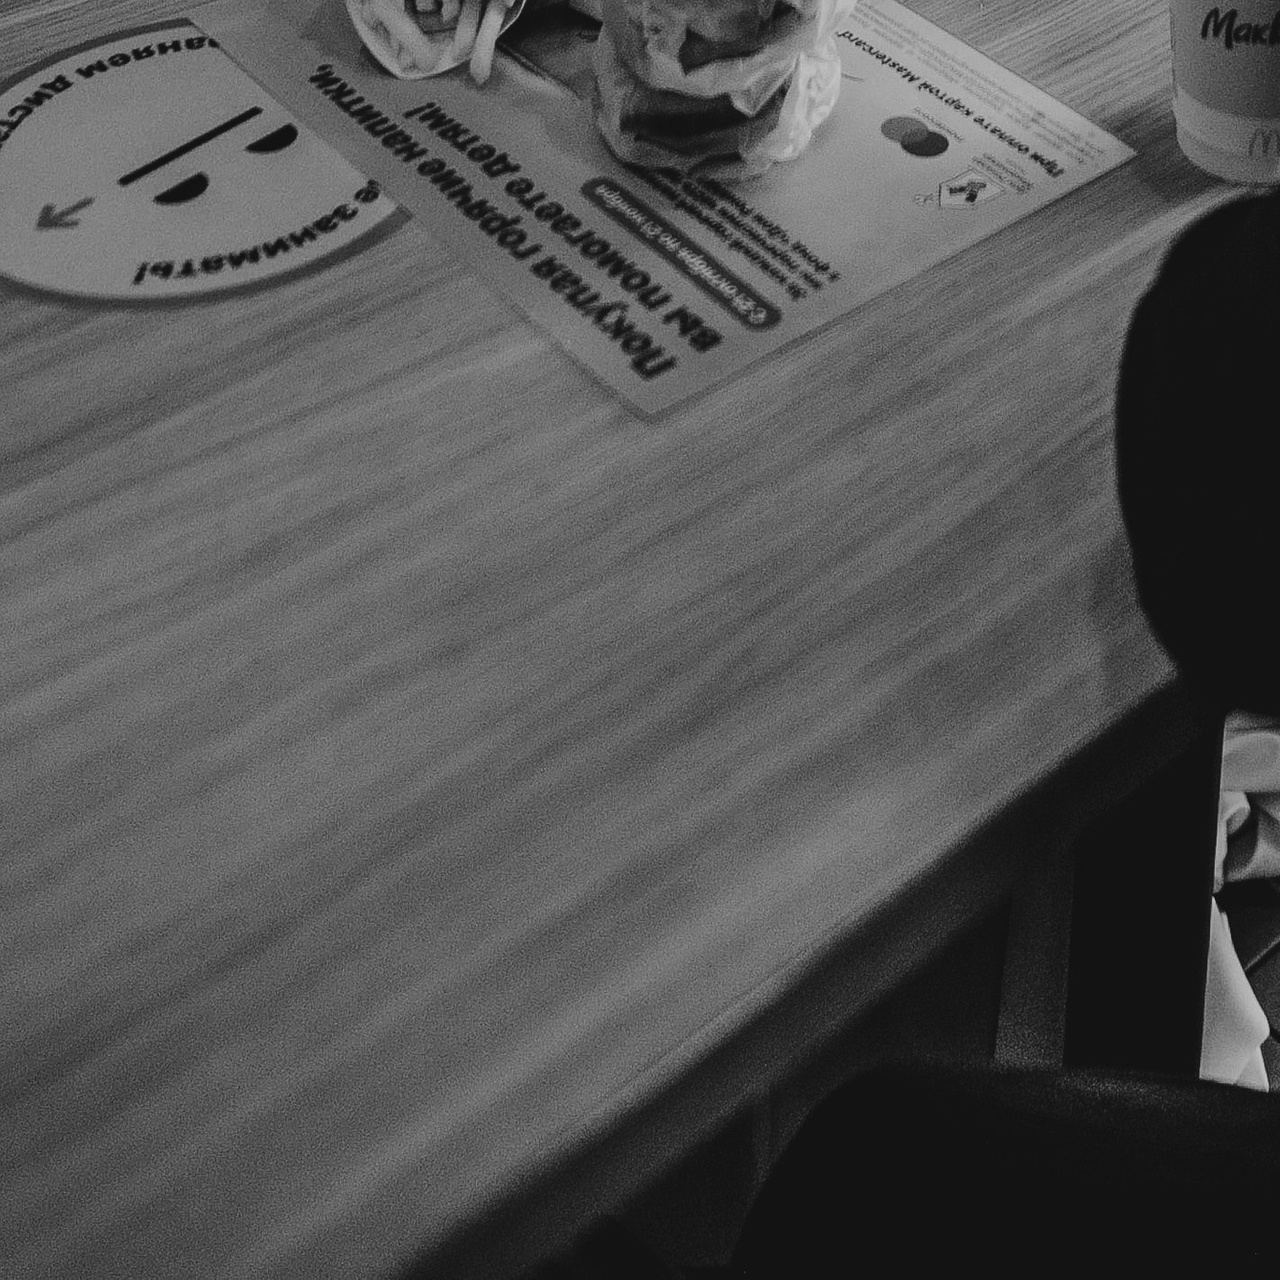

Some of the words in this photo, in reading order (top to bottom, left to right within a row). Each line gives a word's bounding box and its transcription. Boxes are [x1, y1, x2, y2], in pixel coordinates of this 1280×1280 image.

[838, 30, 921, 83] Mastercard
[309, 63, 428, 162] напитки,
[918, 81, 974, 118] картой
[404, 102, 521, 178] детям!
[974, 115, 1029, 154] оплате
[1030, 150, 1064, 177] При
[416, 157, 542, 260] горячие
[595, 184, 650, 224] ноября
[131, 203, 359, 285] занимать!
[505, 177, 673, 311] помогаете
[658, 232, 682, 251] по
[677, 246, 738, 295] октября
[530, 256, 677, 379] Покупая
[663, 305, 722, 353] вы
